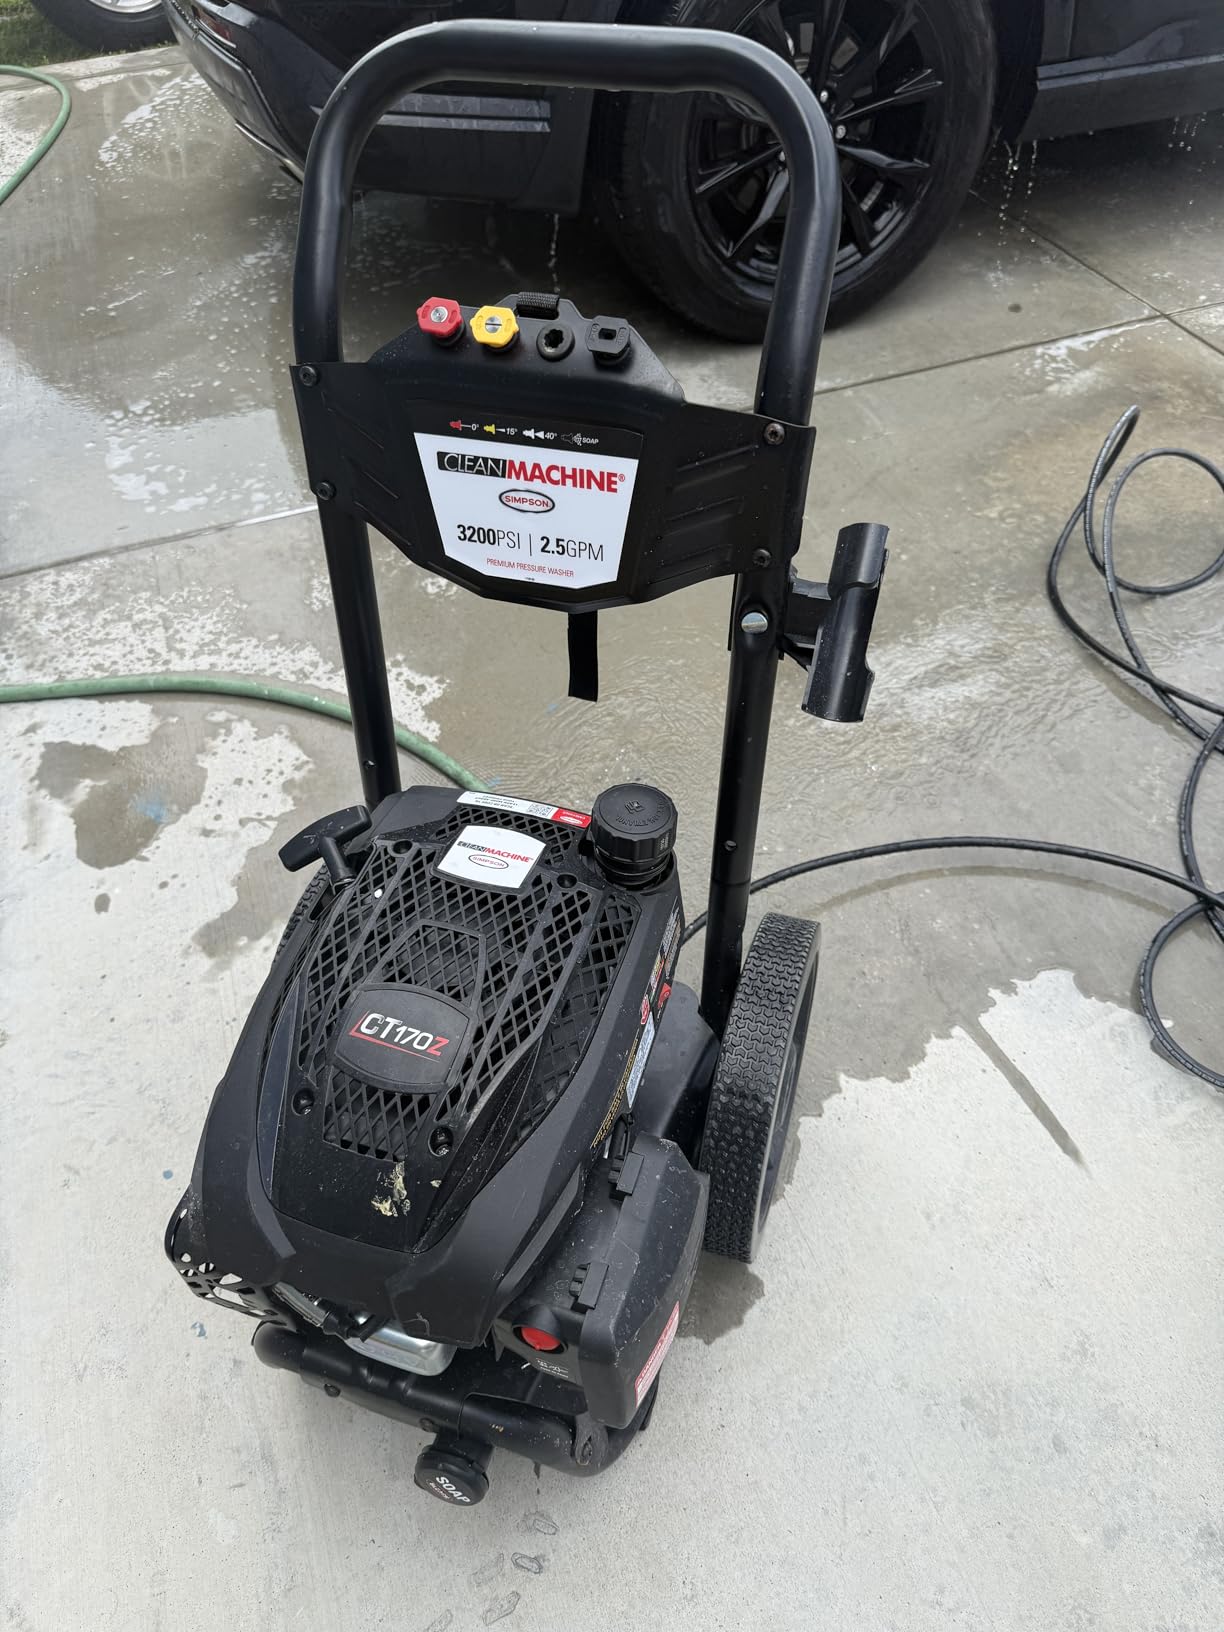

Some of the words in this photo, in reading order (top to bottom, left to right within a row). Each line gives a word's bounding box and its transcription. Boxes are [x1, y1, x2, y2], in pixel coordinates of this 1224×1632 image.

[582, 437, 599, 445] SOAP
[504, 495, 549, 508] SIMPSON
[456, 524, 521, 549] 3200PSI
[540, 536, 604, 562] 2.5GPM
[486, 558, 516, 570] PREMIUM
[516, 562, 547, 574] PRESSURE
[547, 566, 574, 577] WASHER
[472, 856, 505, 867] SIMPSON
[360, 1012, 449, 1057] CT170Z
[436, 1476, 471, 1503] SOAP
